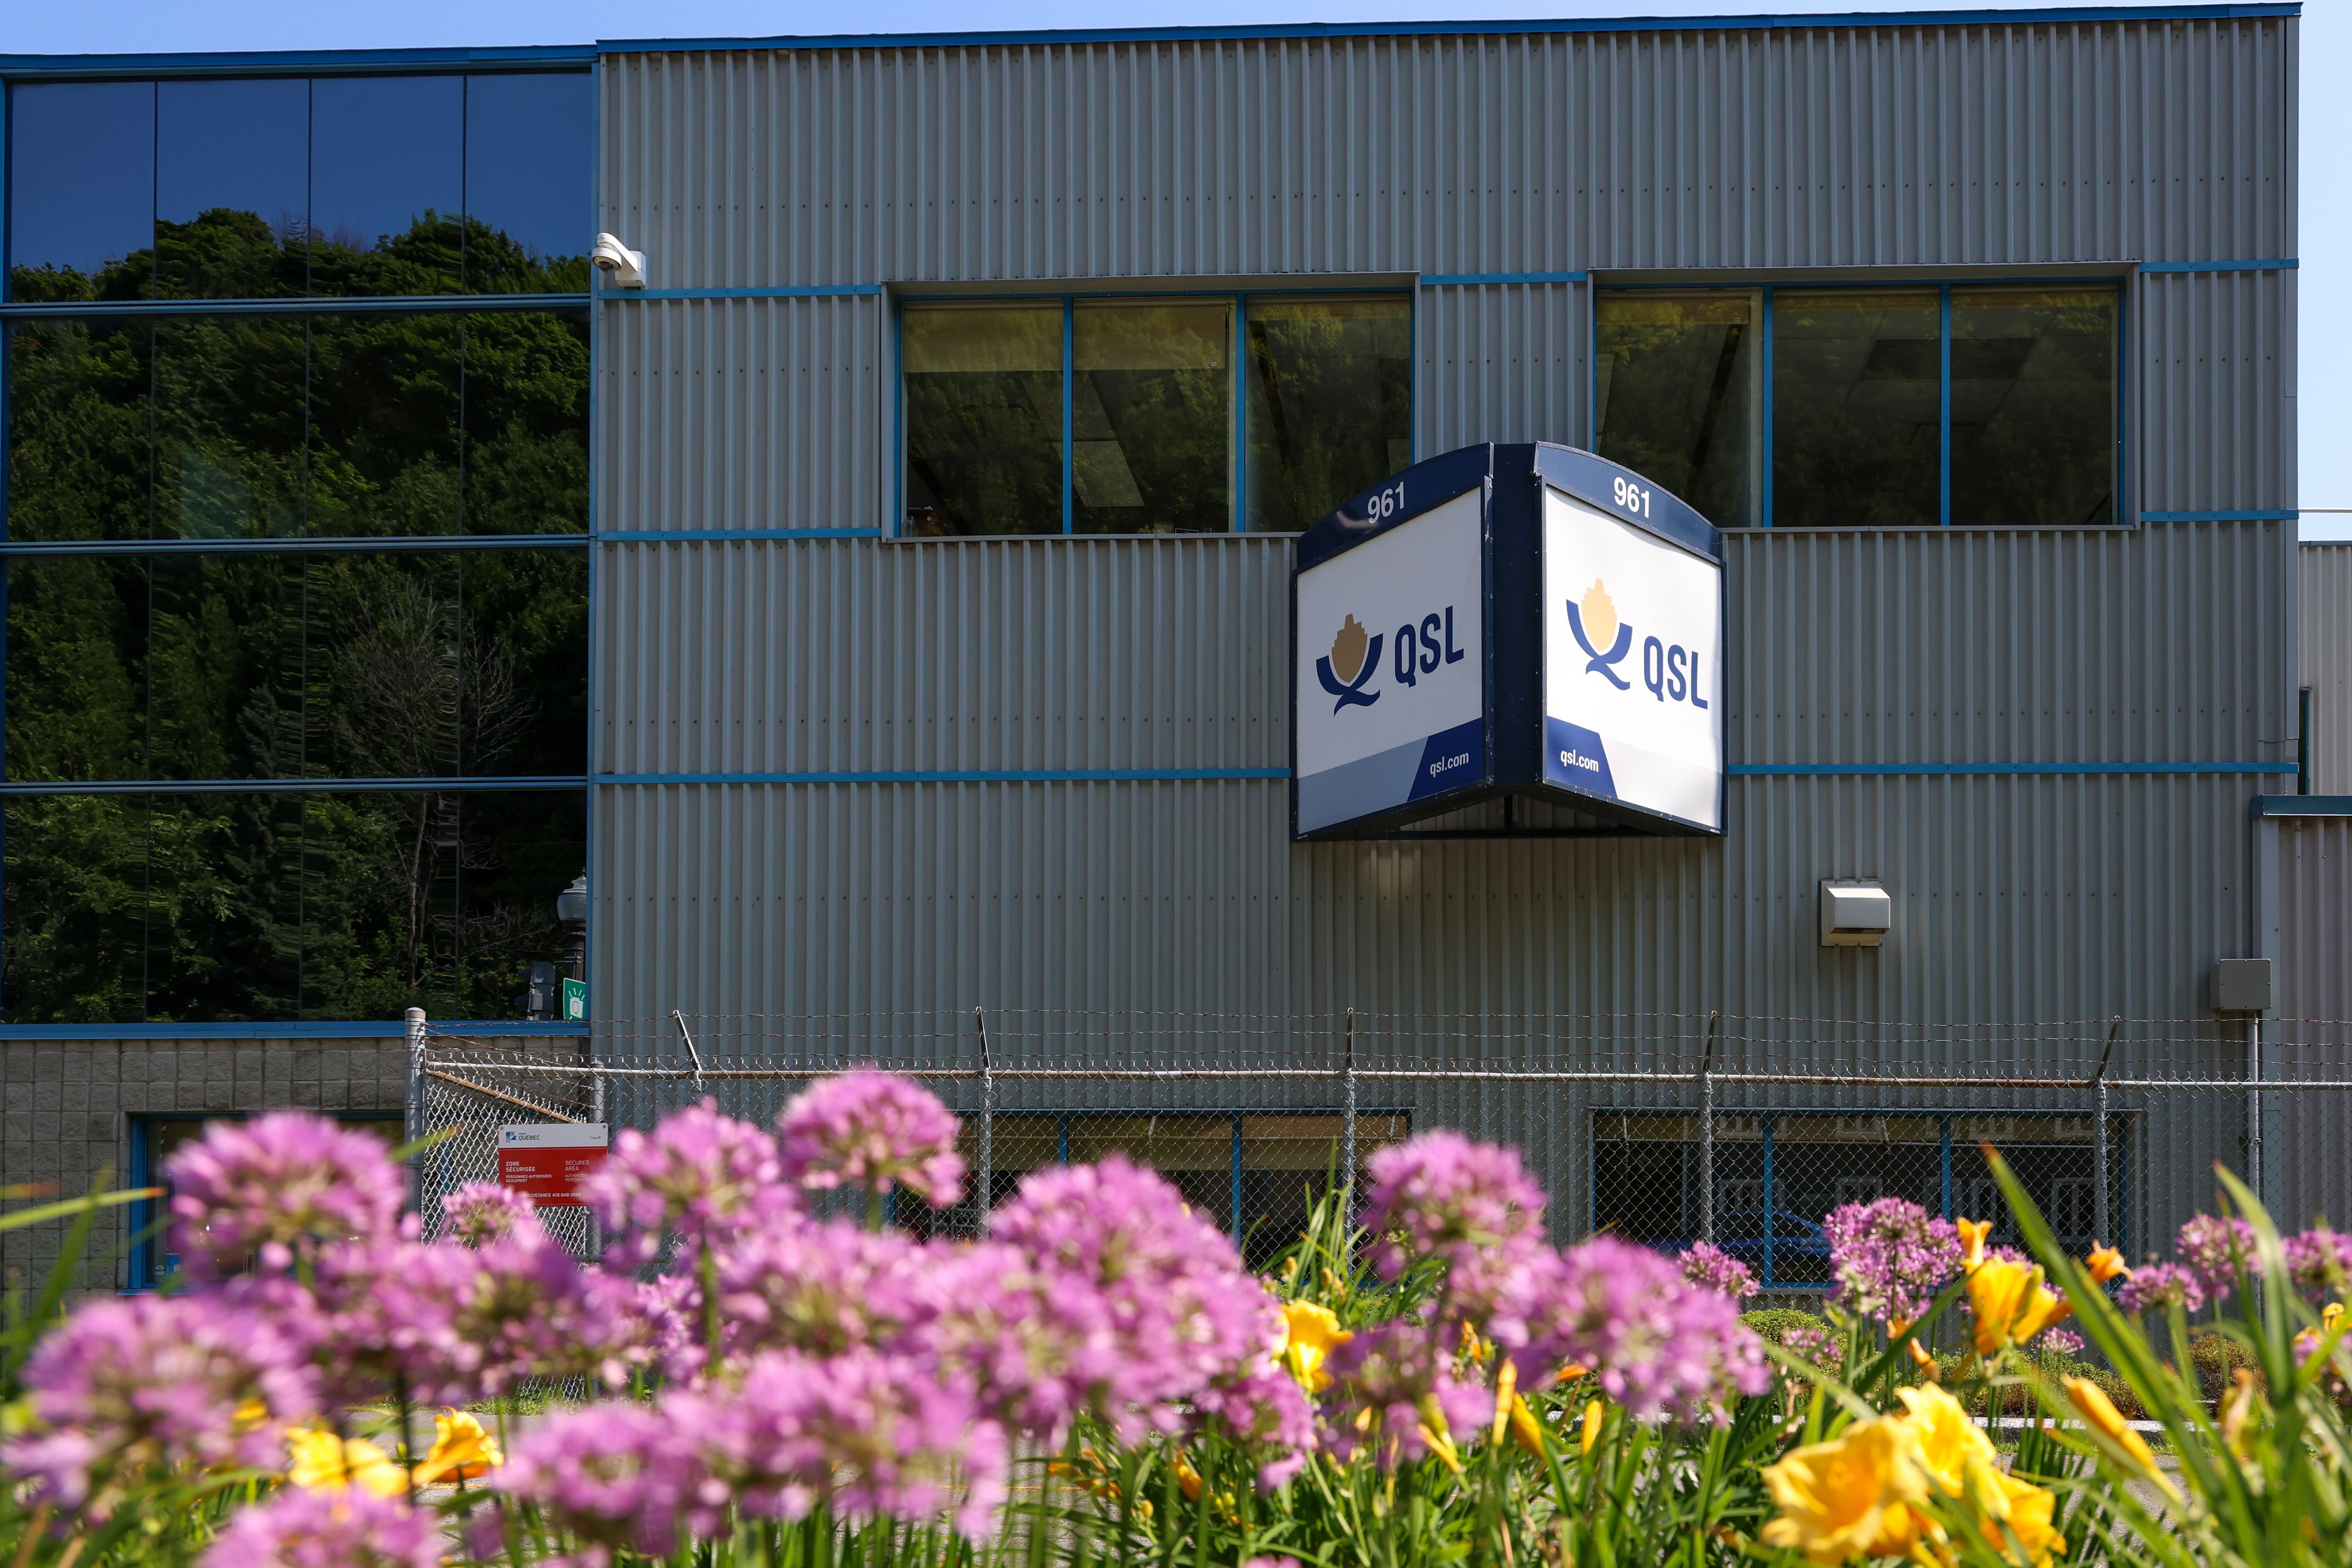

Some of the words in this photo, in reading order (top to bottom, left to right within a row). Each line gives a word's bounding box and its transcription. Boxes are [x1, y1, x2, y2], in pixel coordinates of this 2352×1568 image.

[1367, 481, 1405, 525] 961
[1614, 476, 1650, 518] 961
[1394, 605, 1464, 688] QSL
[1644, 635, 1708, 710] QSL
[1430, 752, 1469, 778] qsl.com
[1560, 749, 1599, 772] qsl.com
